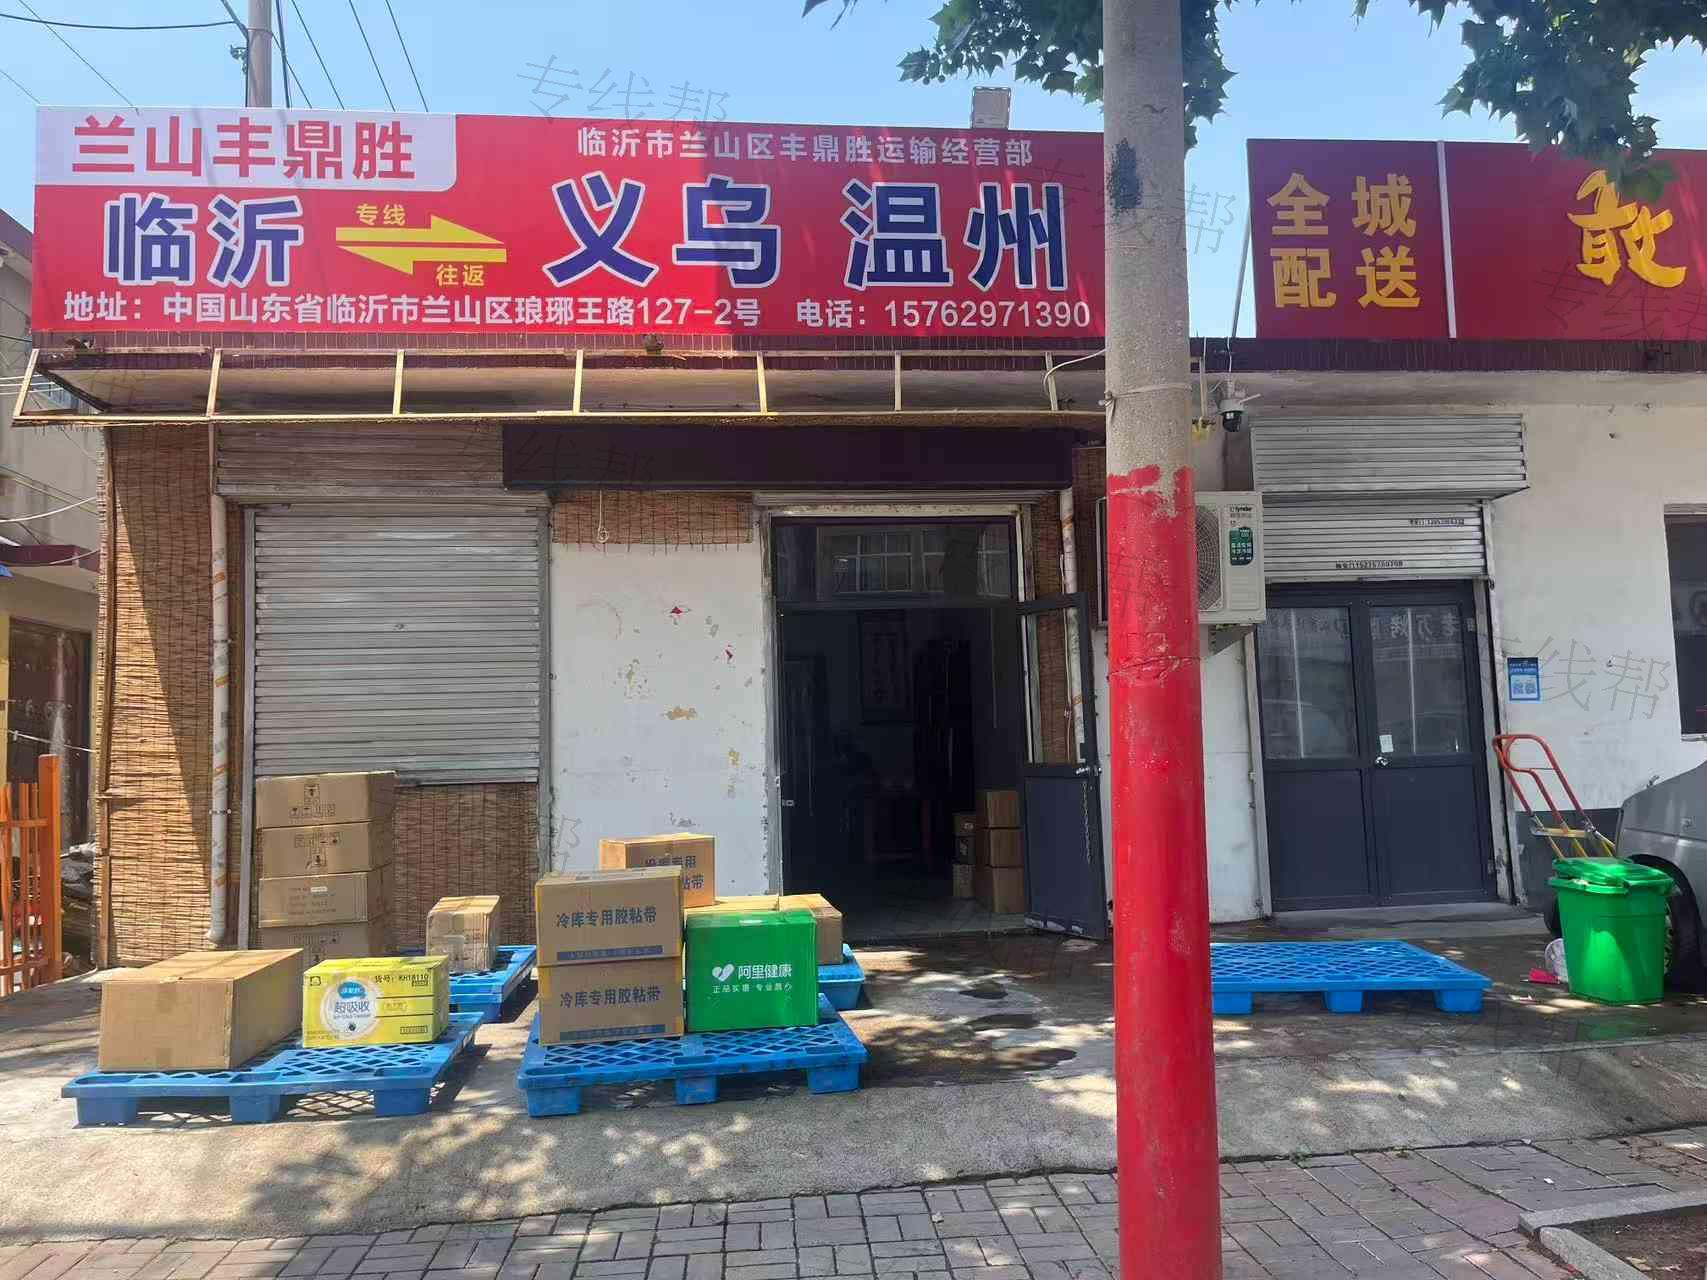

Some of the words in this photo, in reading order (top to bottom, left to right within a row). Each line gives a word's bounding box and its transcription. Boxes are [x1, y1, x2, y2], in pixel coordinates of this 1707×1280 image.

[71, 114, 416, 180] 兰山丰鼎胜
[576, 126, 1034, 168] 临沂市兰山区丰鼎胜运输经营部
[355, 203, 405, 225] 专线
[542, 169, 782, 289] 义乌
[1266, 172, 1417, 238] 全城
[103, 192, 303, 288] 临沂
[840, 177, 1069, 291] 温州
[435, 264, 485, 287] 往返
[1270, 245, 1421, 309] 配送
[63, 291, 761, 329] 地址：中国山东省临沂市兰山区琅琊王路127-2号
[796, 298, 1091, 330] 电话：15762971390
[737, 963, 792, 981] 阿里健康
